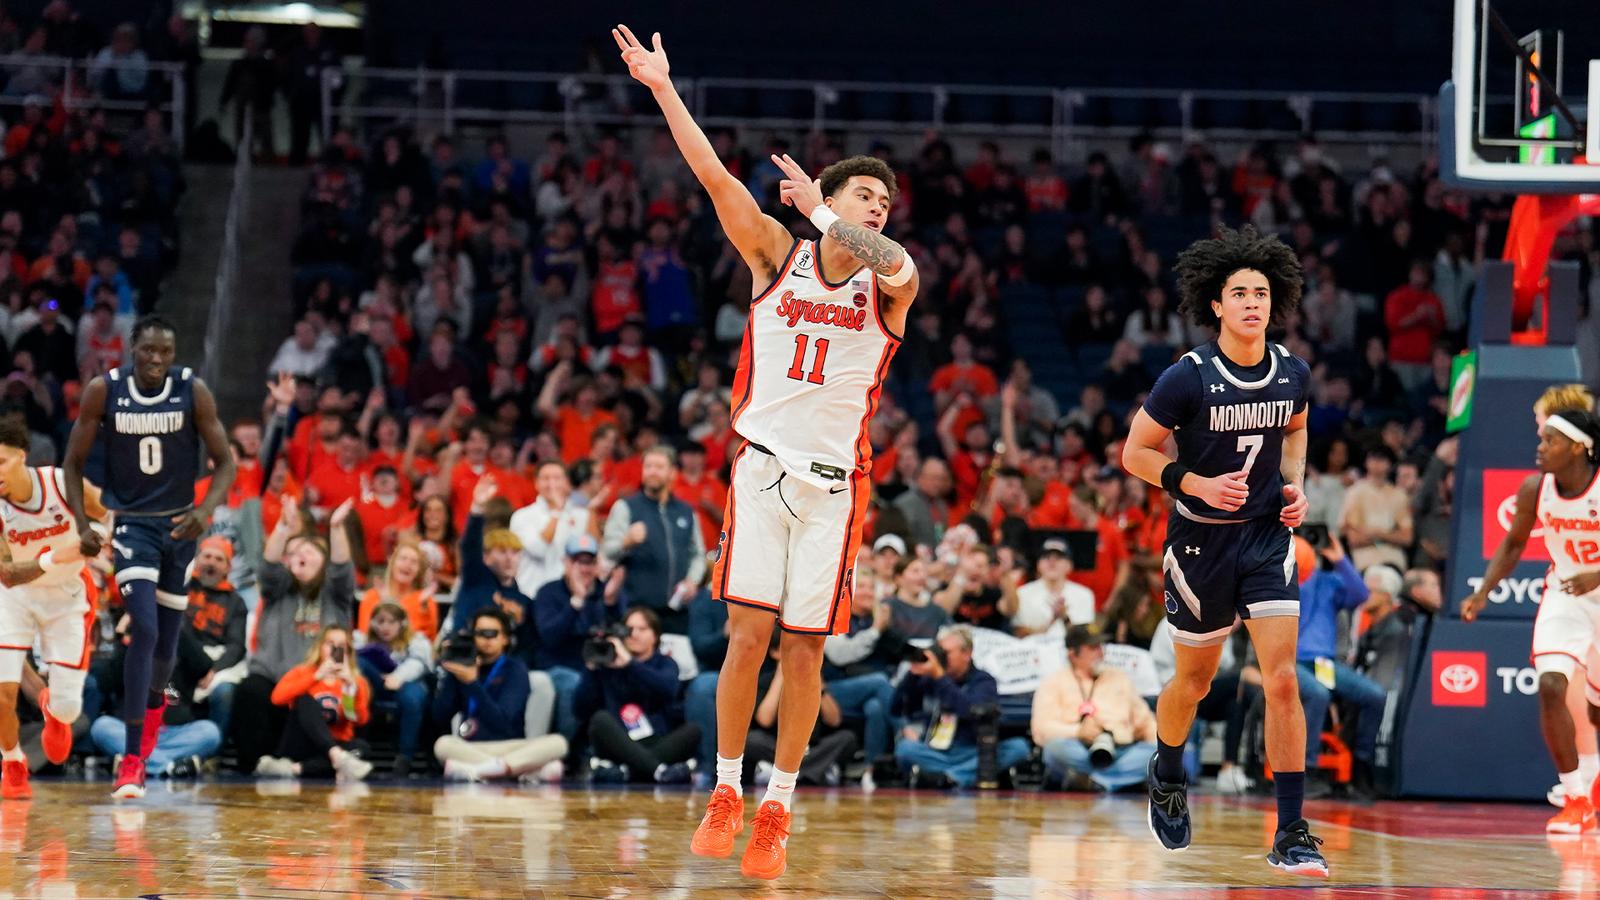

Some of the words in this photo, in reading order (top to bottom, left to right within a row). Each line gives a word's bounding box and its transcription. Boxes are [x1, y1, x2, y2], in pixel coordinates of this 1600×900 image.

[776, 290, 867, 332] Syracuse
[787, 333, 830, 385] 11
[115, 411, 184, 435] MONMOUTH
[1209, 400, 1294, 432] MONMOUTH
[139, 436, 162, 475] 0
[1236, 434, 1264, 482] 7
[8, 520, 70, 546] Syracuse
[1565, 539, 1600, 564] 12
